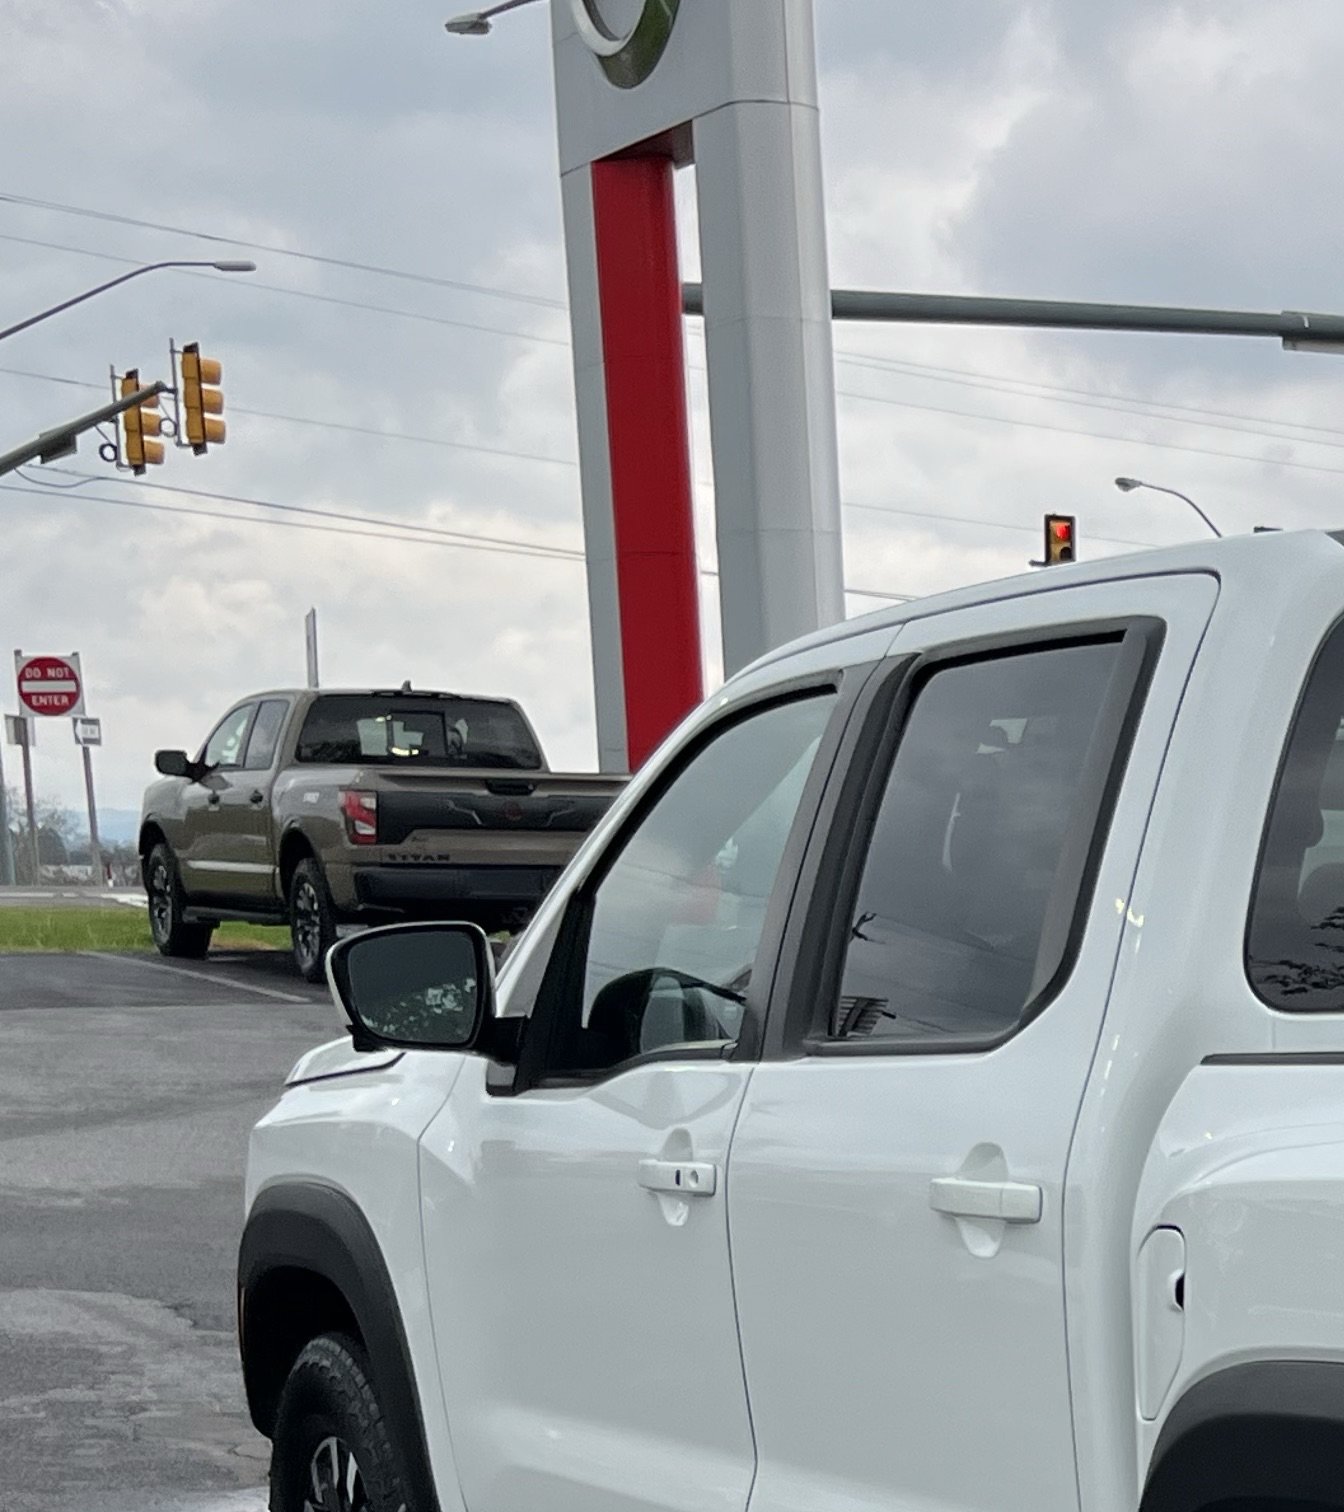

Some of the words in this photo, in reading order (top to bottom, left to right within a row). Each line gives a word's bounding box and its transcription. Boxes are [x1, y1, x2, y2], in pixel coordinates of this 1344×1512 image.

[25, 667, 42, 679] DO
[46, 667, 70, 678] NOT
[31, 694, 70, 706] ENTER
